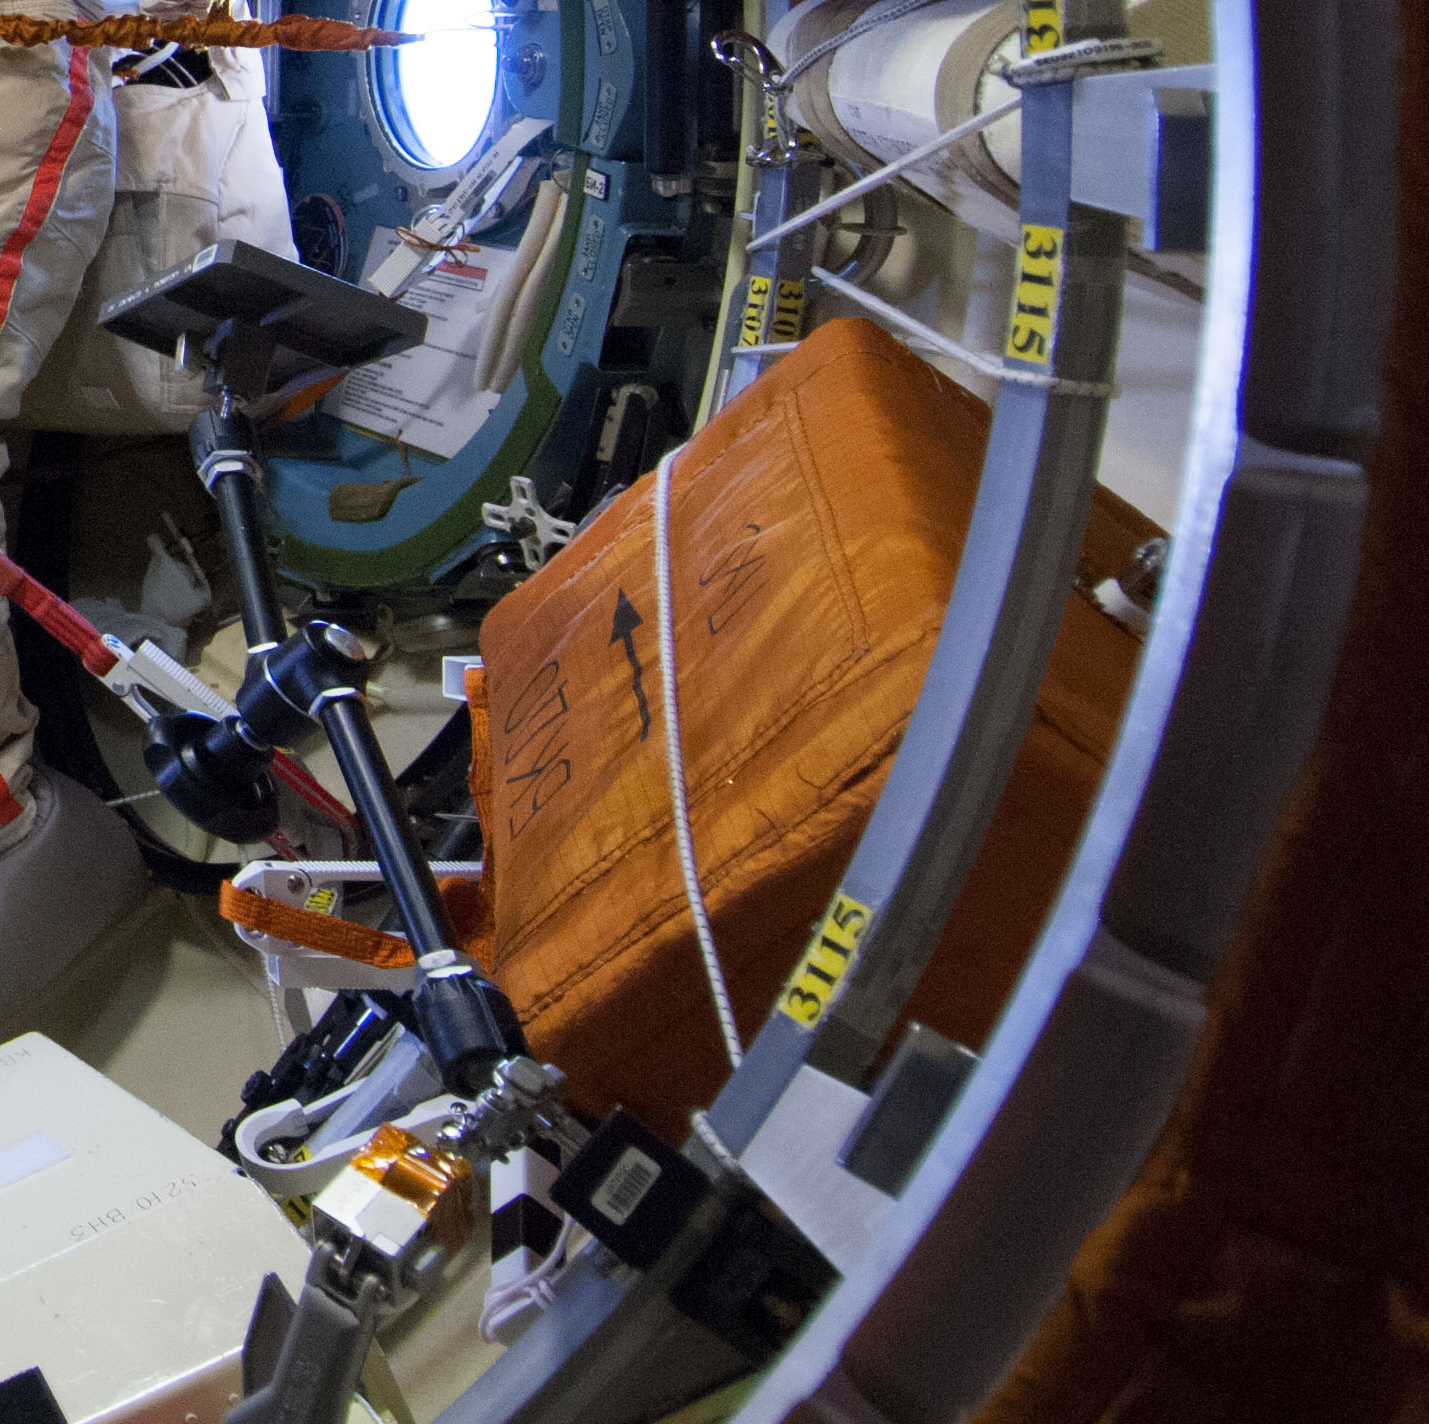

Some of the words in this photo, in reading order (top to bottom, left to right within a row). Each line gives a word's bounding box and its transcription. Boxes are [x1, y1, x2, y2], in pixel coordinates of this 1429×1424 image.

[744, 279, 768, 346] 3107
[773, 282, 804, 337] 310
[1009, 229, 1059, 358] 3115
[786, 901, 867, 1024] 3115
